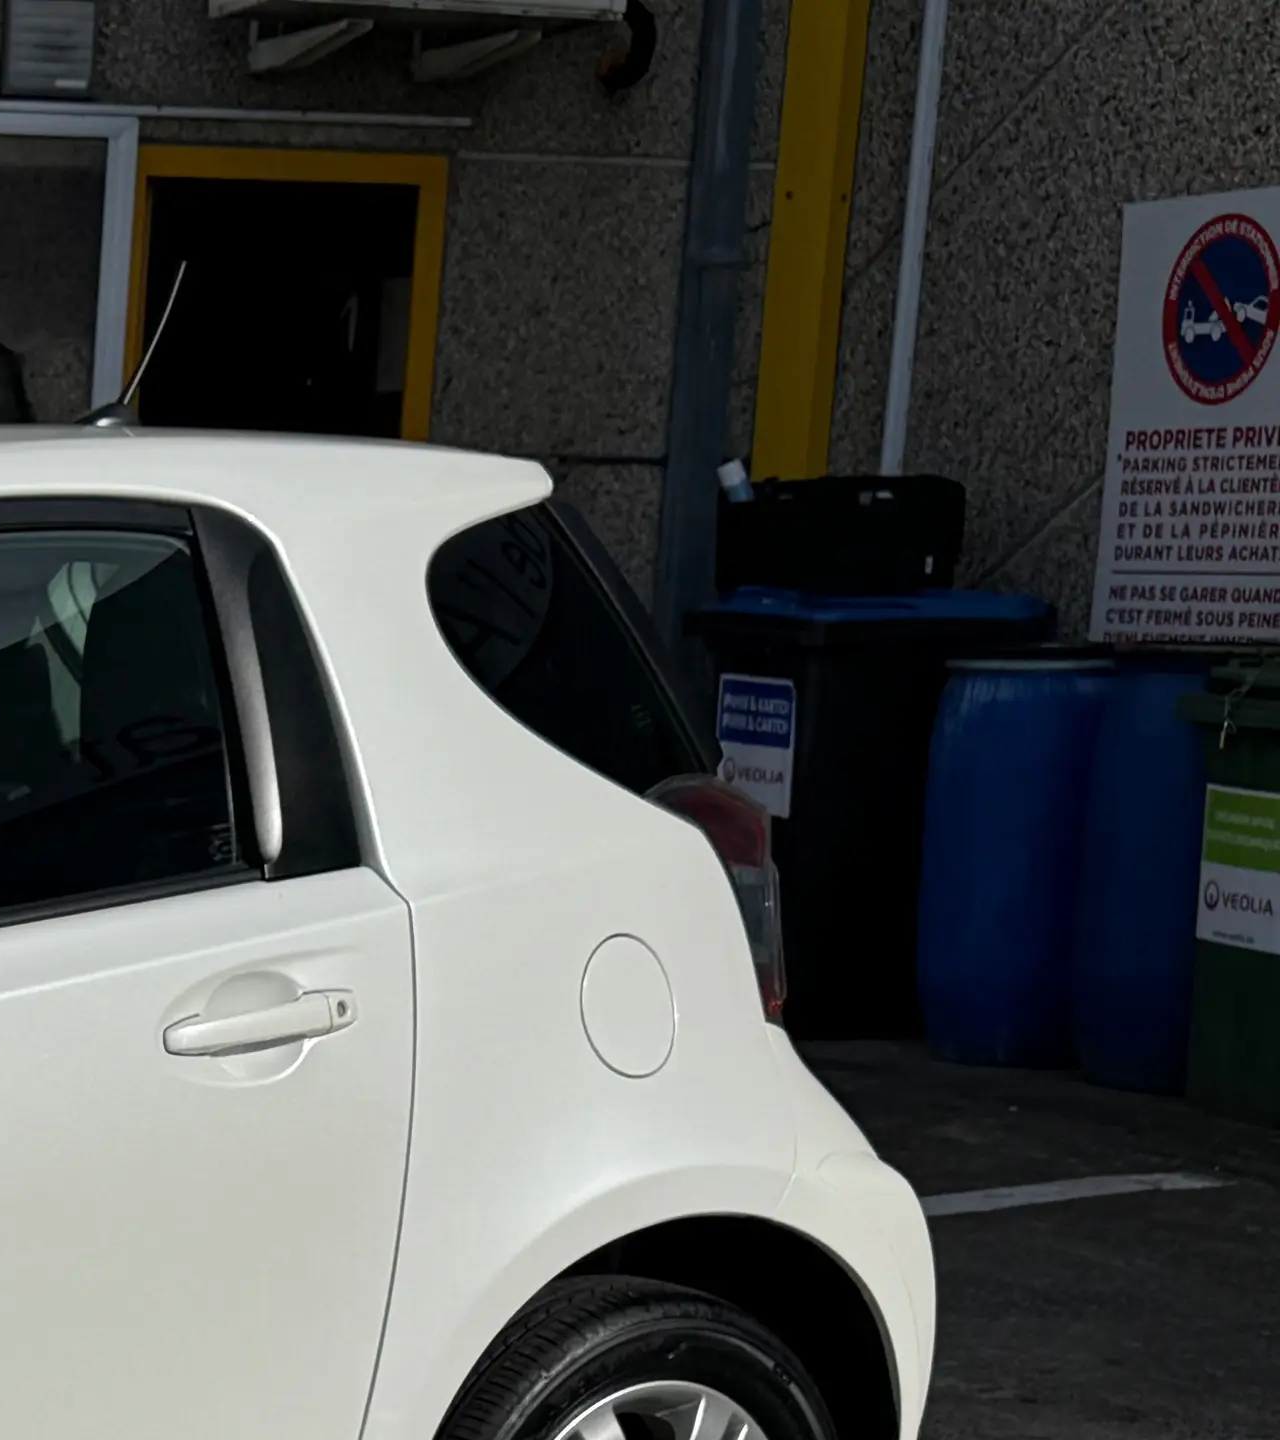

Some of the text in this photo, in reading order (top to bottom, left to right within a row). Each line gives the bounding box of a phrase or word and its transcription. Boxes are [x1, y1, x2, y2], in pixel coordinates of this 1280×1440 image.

[1125, 428, 1227, 451] PROPRIETE
[1123, 454, 1280, 473] PARKING STRICTEME
[1198, 479, 1215, 494] LA
[1119, 502, 1138, 517] DE
[1144, 501, 1162, 517] LA
[1117, 523, 1135, 539] ET
[1142, 523, 1163, 538] DE
[1171, 523, 1190, 539] LA
[1114, 544, 1280, 563] DURANT LEURS ACHAT
[1109, 586, 1280, 604] NE PAS SE GARER QUAND
[1195, 611, 1234, 627] SOUS
[1239, 612, 1280, 628] PEINE
[1222, 892, 1274, 916] VEOLIA
